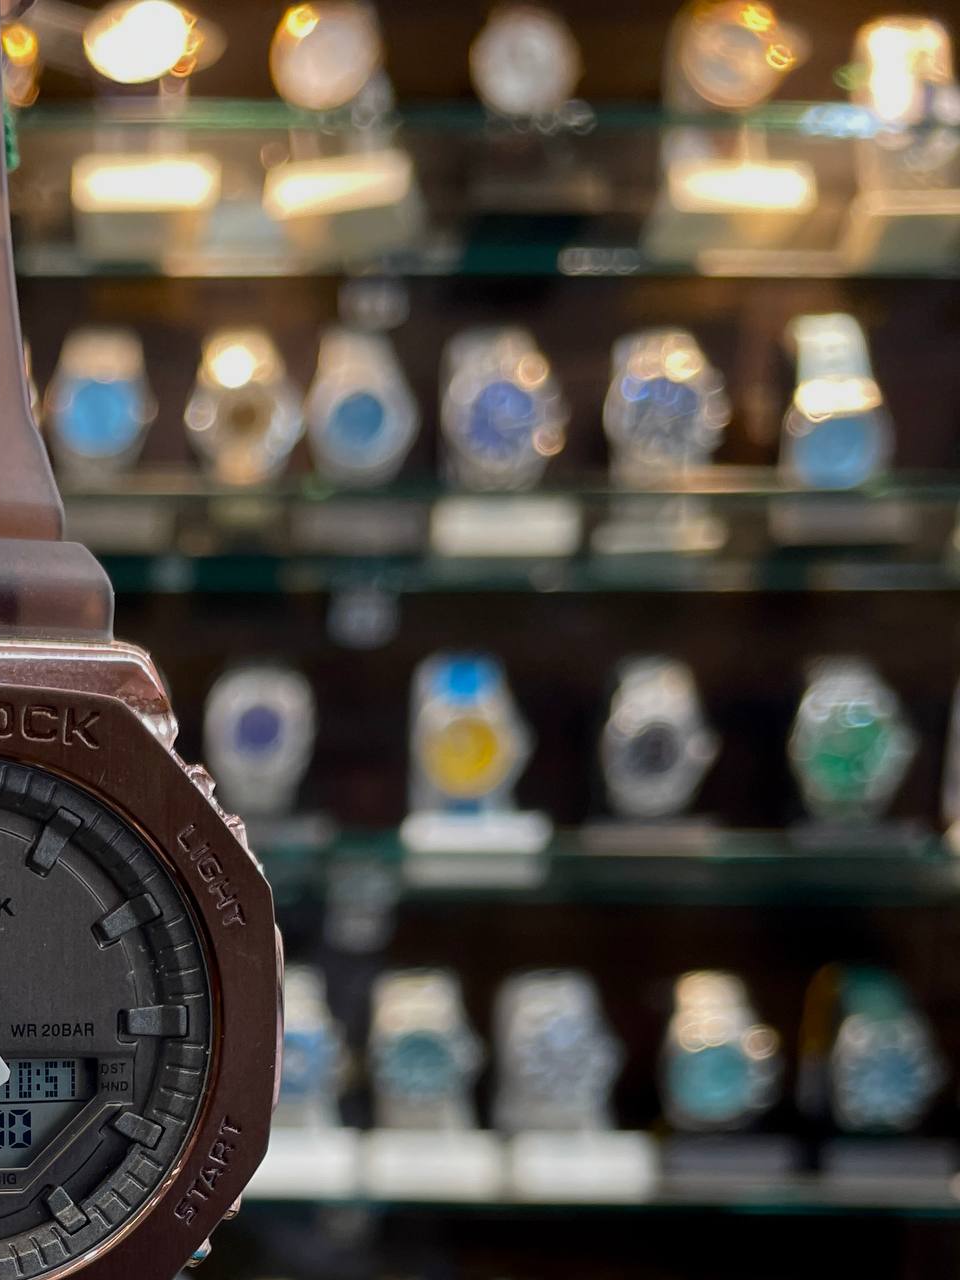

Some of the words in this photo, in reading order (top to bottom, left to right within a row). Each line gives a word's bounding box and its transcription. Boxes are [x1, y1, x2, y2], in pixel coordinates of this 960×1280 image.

[177, 823, 246, 926] LIGHT
[11, 1024, 38, 1038] WR
[42, 1023, 95, 1037] 20BAR
[101, 1063, 127, 1074] DST
[101, 1081, 129, 1092] HND
[173, 1115, 241, 1226] START
